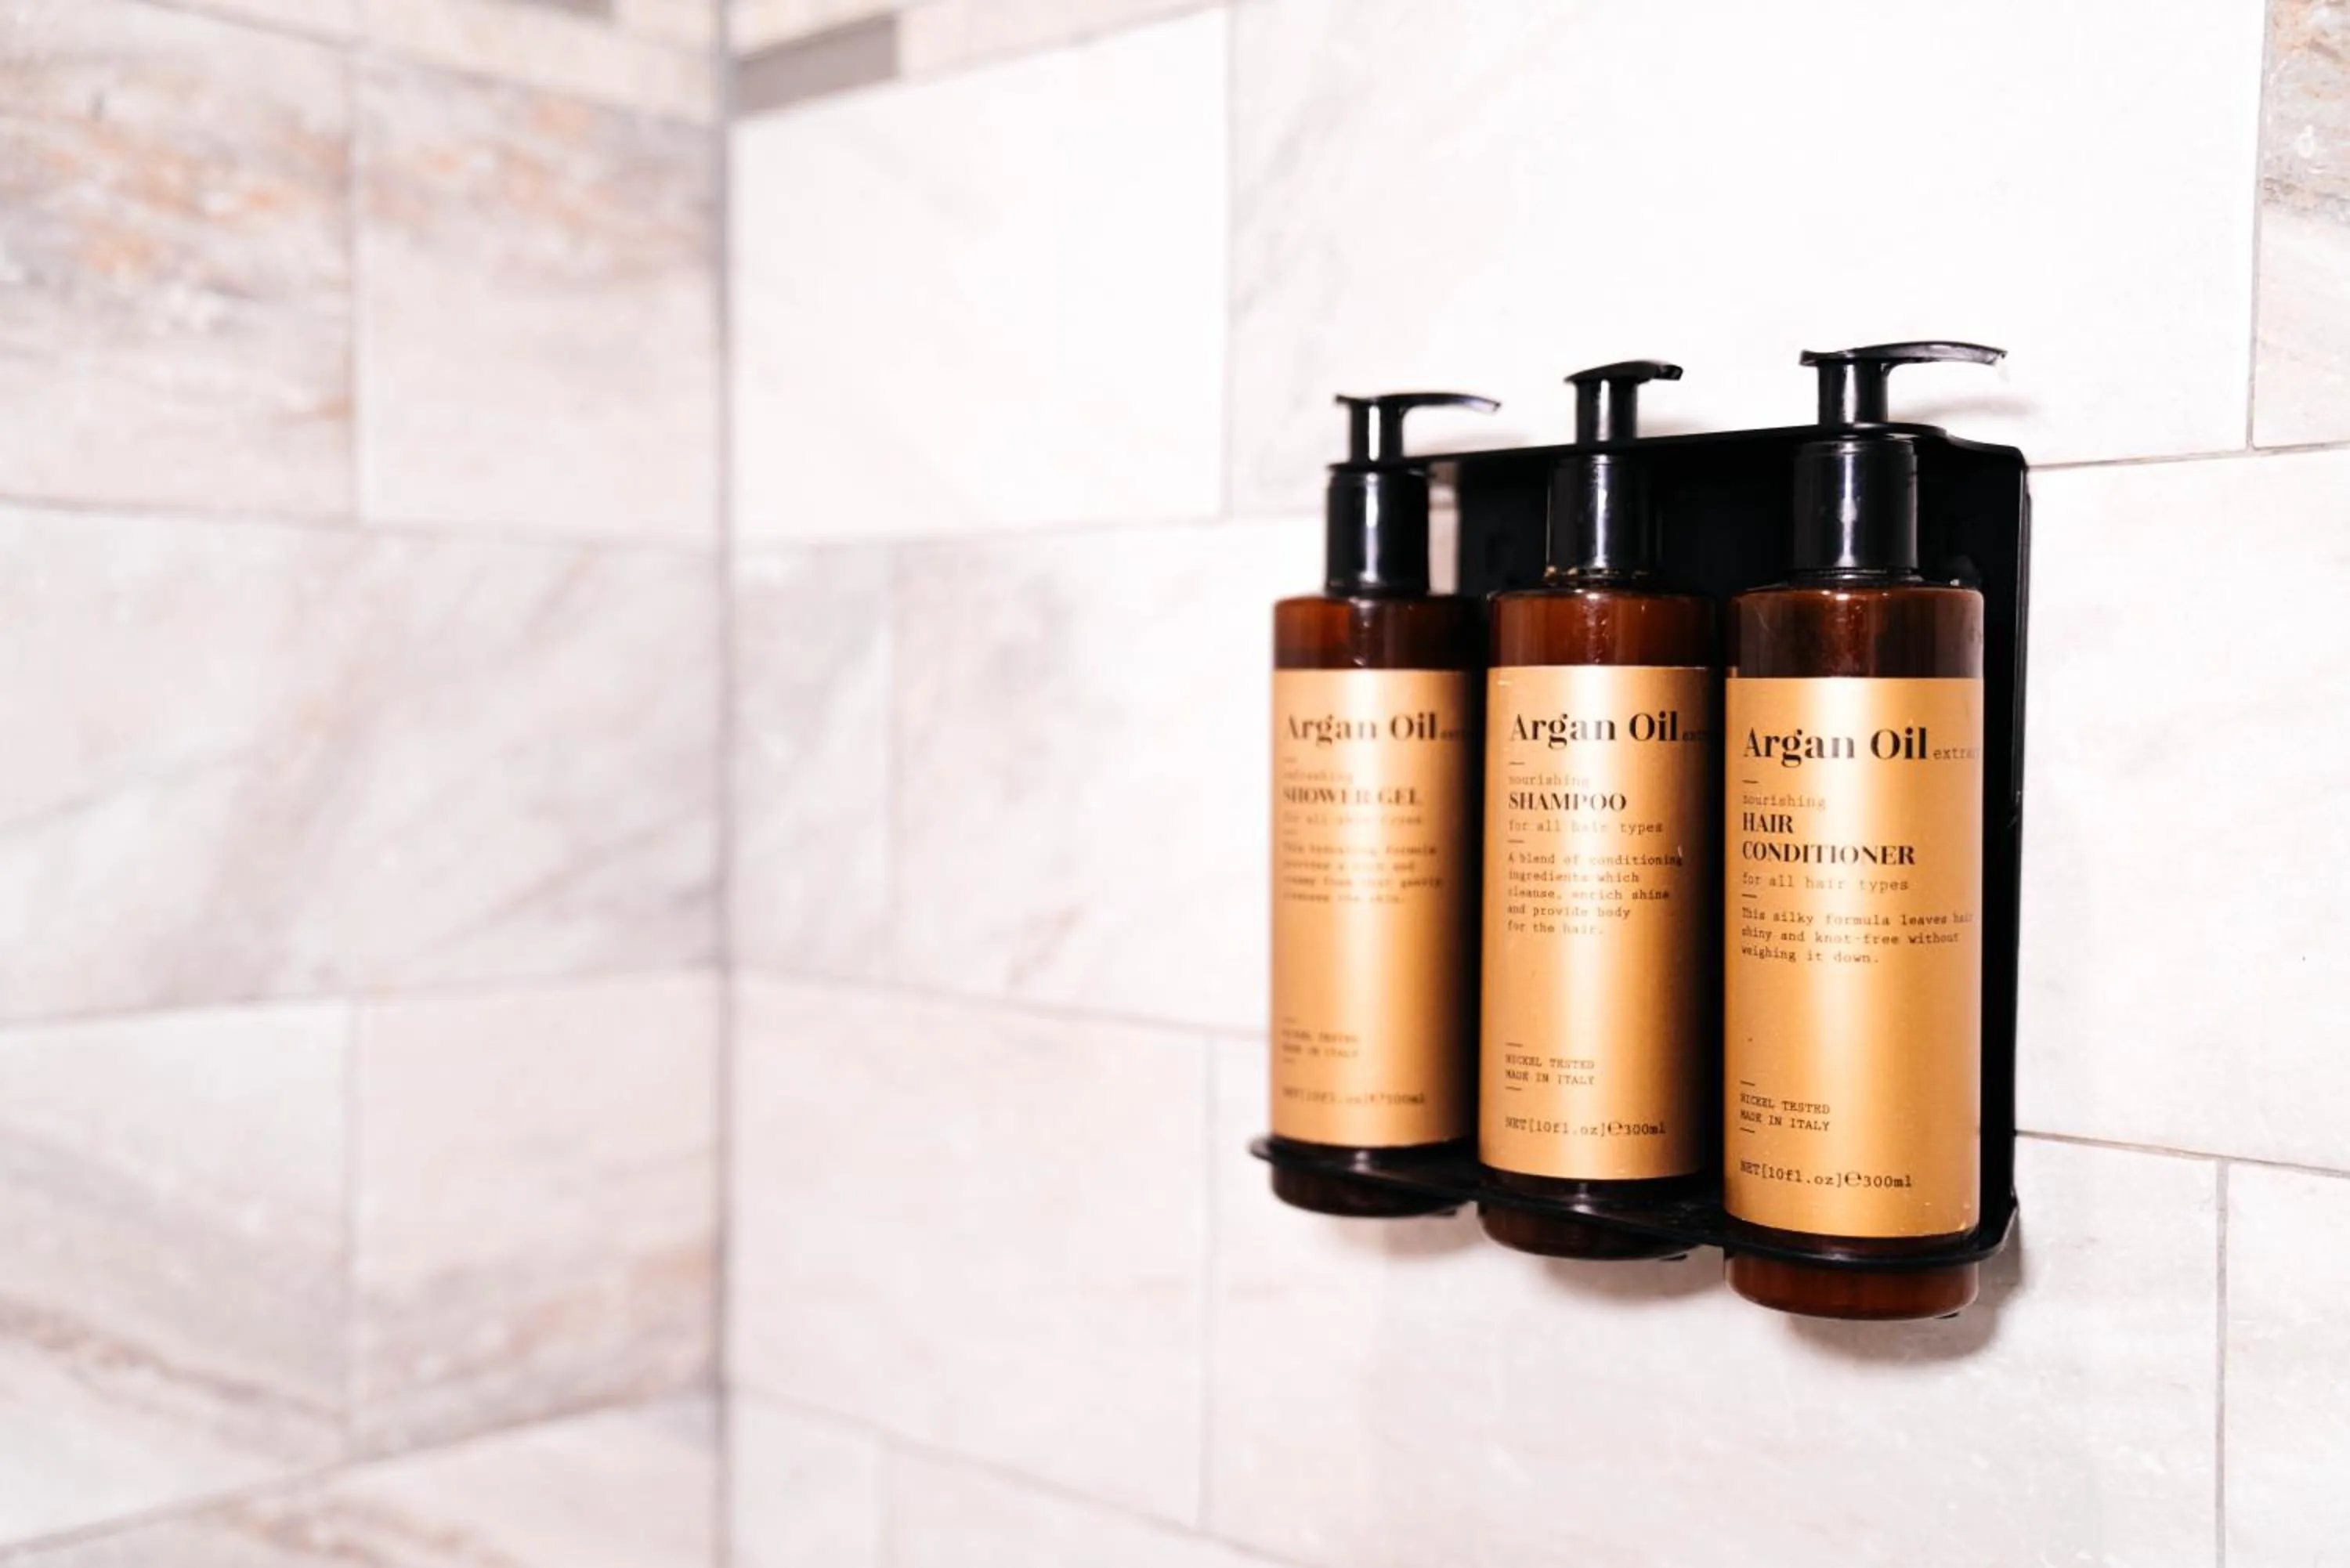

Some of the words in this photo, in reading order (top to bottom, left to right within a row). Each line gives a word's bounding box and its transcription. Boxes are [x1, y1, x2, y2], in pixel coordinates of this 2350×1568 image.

[1285, 713, 1378, 746] Argan
[1390, 712, 1437, 741] Oil
[1509, 713, 1617, 750] Argan
[1629, 710, 1679, 742] Oil
[1743, 727, 1856, 768] Argan
[1870, 727, 1927, 760] Oil
[1508, 774, 1590, 789] nourishing
[1283, 788, 1371, 804] SHOWER
[1379, 788, 1423, 805] GEL
[1508, 792, 1627, 812] SHAMPOO
[1742, 794, 1826, 811] nourishing
[1508, 820, 1528, 831] for
[1537, 820, 1560, 832] all
[1571, 821, 1607, 833] hair
[1620, 822, 1664, 836] types
[1742, 812, 1794, 833] HAIR
[1520, 854, 1555, 864] blend
[1589, 854, 1683, 866] conditioning
[1742, 841, 1916, 865] CONDITIONER
[1508, 871, 1589, 883] ingredients
[1597, 873, 1640, 883] which
[1742, 873, 1761, 884] for
[1769, 875, 1795, 887] all
[1805, 876, 1845, 890] hair
[1859, 877, 1909, 893] types
[1571, 889, 1623, 900] enrich
[1632, 890, 1669, 900] shine
[1507, 905, 1525, 915] and
[1532, 907, 1588, 918] provide
[1597, 907, 1630, 919] body
[1742, 906, 1766, 920] This
[1773, 910, 1814, 924] silky
[1824, 913, 1890, 926] formula
[1900, 915, 1947, 926] leaves
[1507, 920, 1526, 932] for
[1532, 923, 1555, 933] the
[1741, 925, 1772, 941] shiny
[1781, 931, 1805, 941] and
[1814, 933, 1899, 945] knot-free
[1908, 933, 1959, 945] without
[1741, 945, 1796, 962] weighing
[1806, 950, 1823, 961] it
[1834, 952, 1879, 963] down.
[1506, 1054, 1542, 1067] NICKEL
[1549, 1058, 1595, 1069] TESTED
[1506, 1070, 1529, 1081] MADE
[1536, 1073, 1549, 1082] IN
[1557, 1075, 1595, 1085] ITALY
[1741, 1093, 1775, 1109] NICKEL
[1781, 1101, 1830, 1115] TESTED
[1741, 1109, 1762, 1123] MADE
[1769, 1115, 1781, 1125] IN
[1791, 1118, 1830, 1131] ITALY
